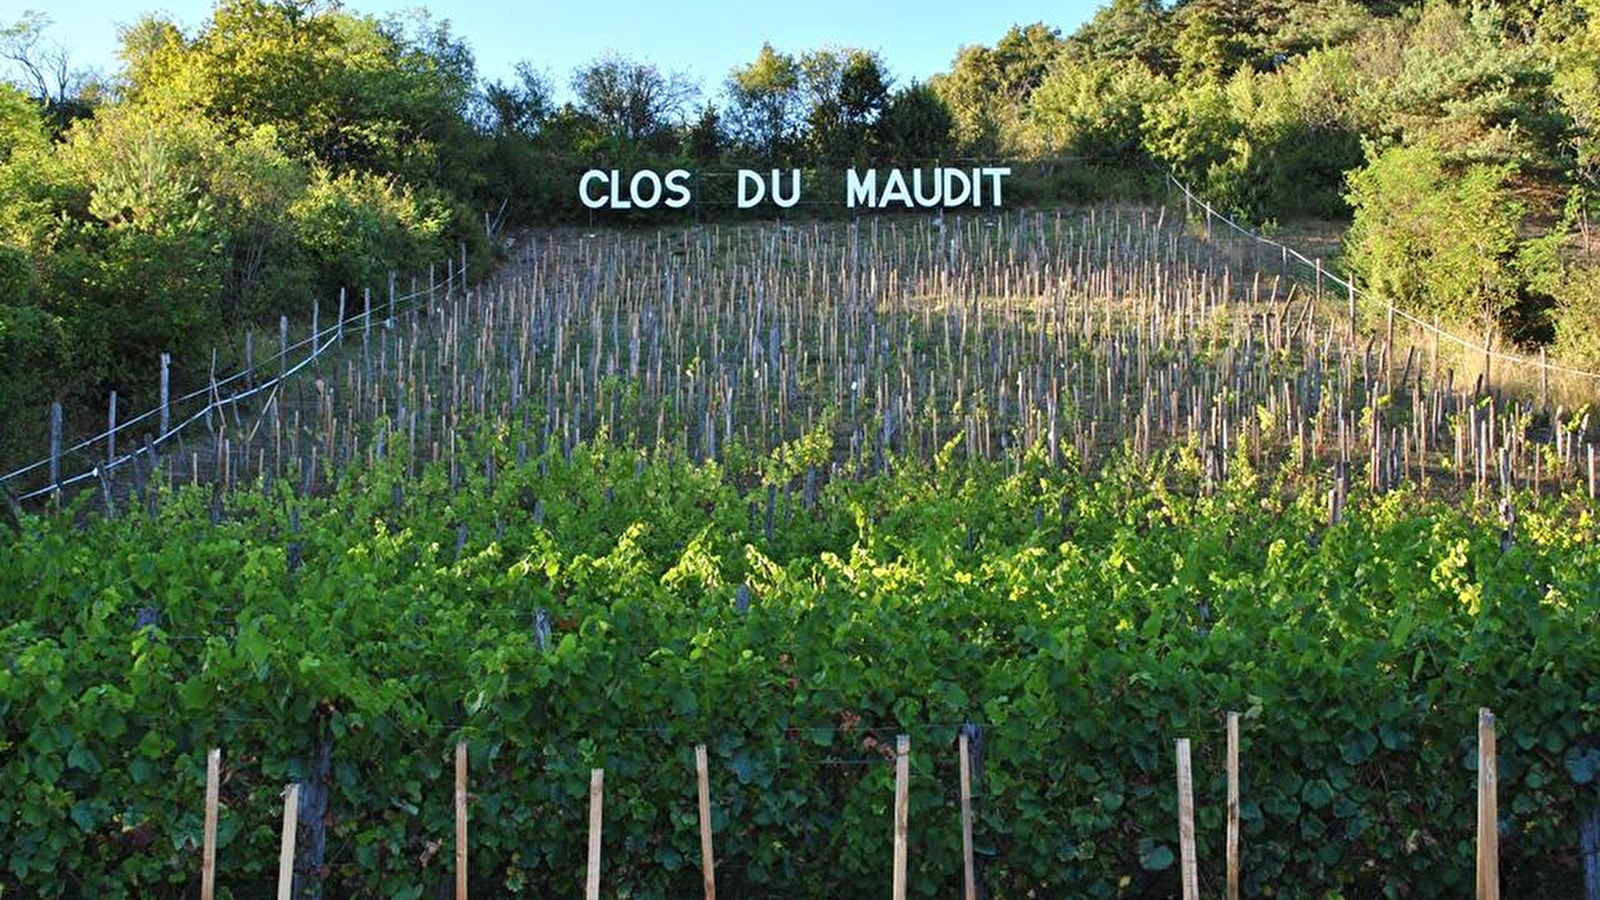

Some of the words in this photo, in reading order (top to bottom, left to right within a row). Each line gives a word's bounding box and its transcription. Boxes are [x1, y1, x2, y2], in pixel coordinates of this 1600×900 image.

[579, 169, 691, 209] CLOS
[737, 169, 801, 208] DU
[847, 167, 1011, 208] MAUDIT
